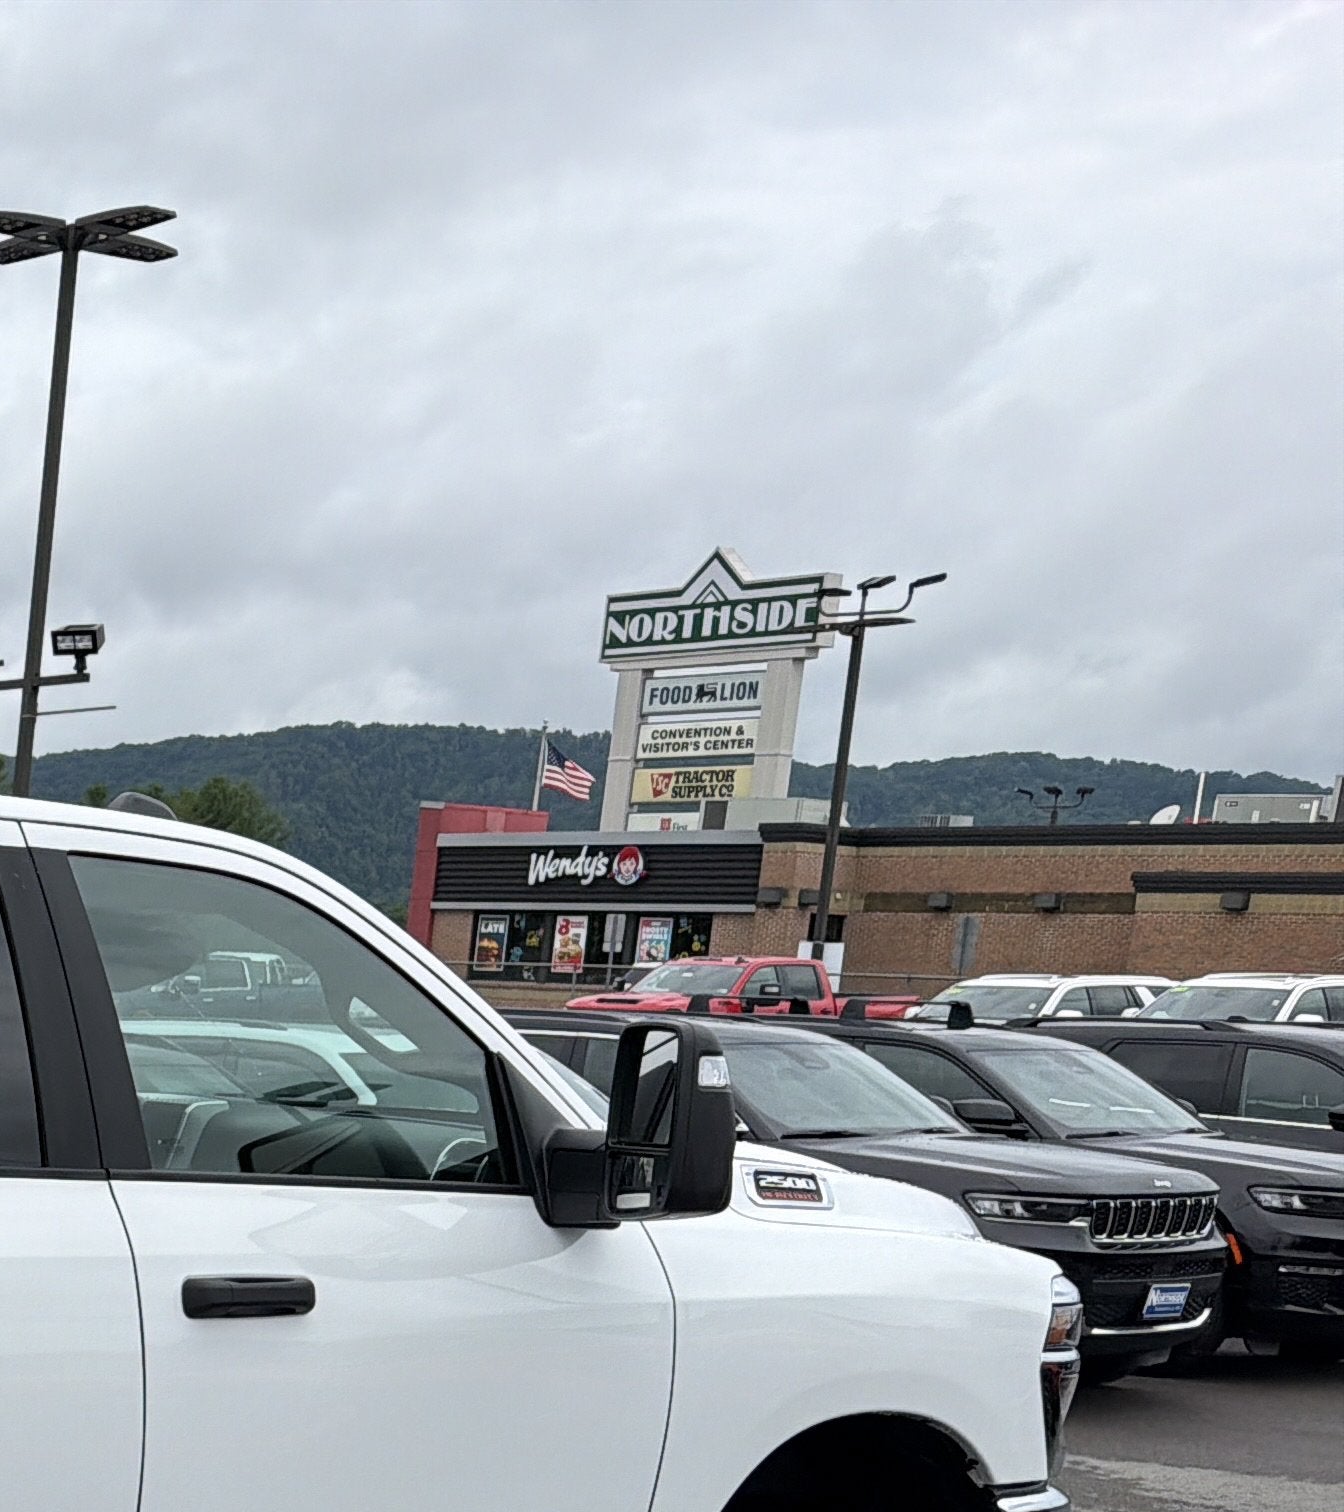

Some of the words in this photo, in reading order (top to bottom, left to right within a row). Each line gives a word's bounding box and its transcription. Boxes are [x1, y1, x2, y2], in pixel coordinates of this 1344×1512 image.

[606, 597, 818, 645] NORTHSIDE
[649, 685, 692, 706] FOOD
[719, 680, 759, 702] LION
[651, 726, 732, 741] CONVENTION
[735, 725, 745, 736] &
[641, 740, 700, 753] VISITOR'S
[703, 738, 754, 751] CENTER
[652, 774, 669, 792] TSC
[673, 769, 737, 785] TRACTOR
[671, 784, 717, 799] SUPPLY
[527, 845, 609, 886] Wendy's
[481, 920, 506, 933] LATE
[757, 1174, 816, 1191] 2500
